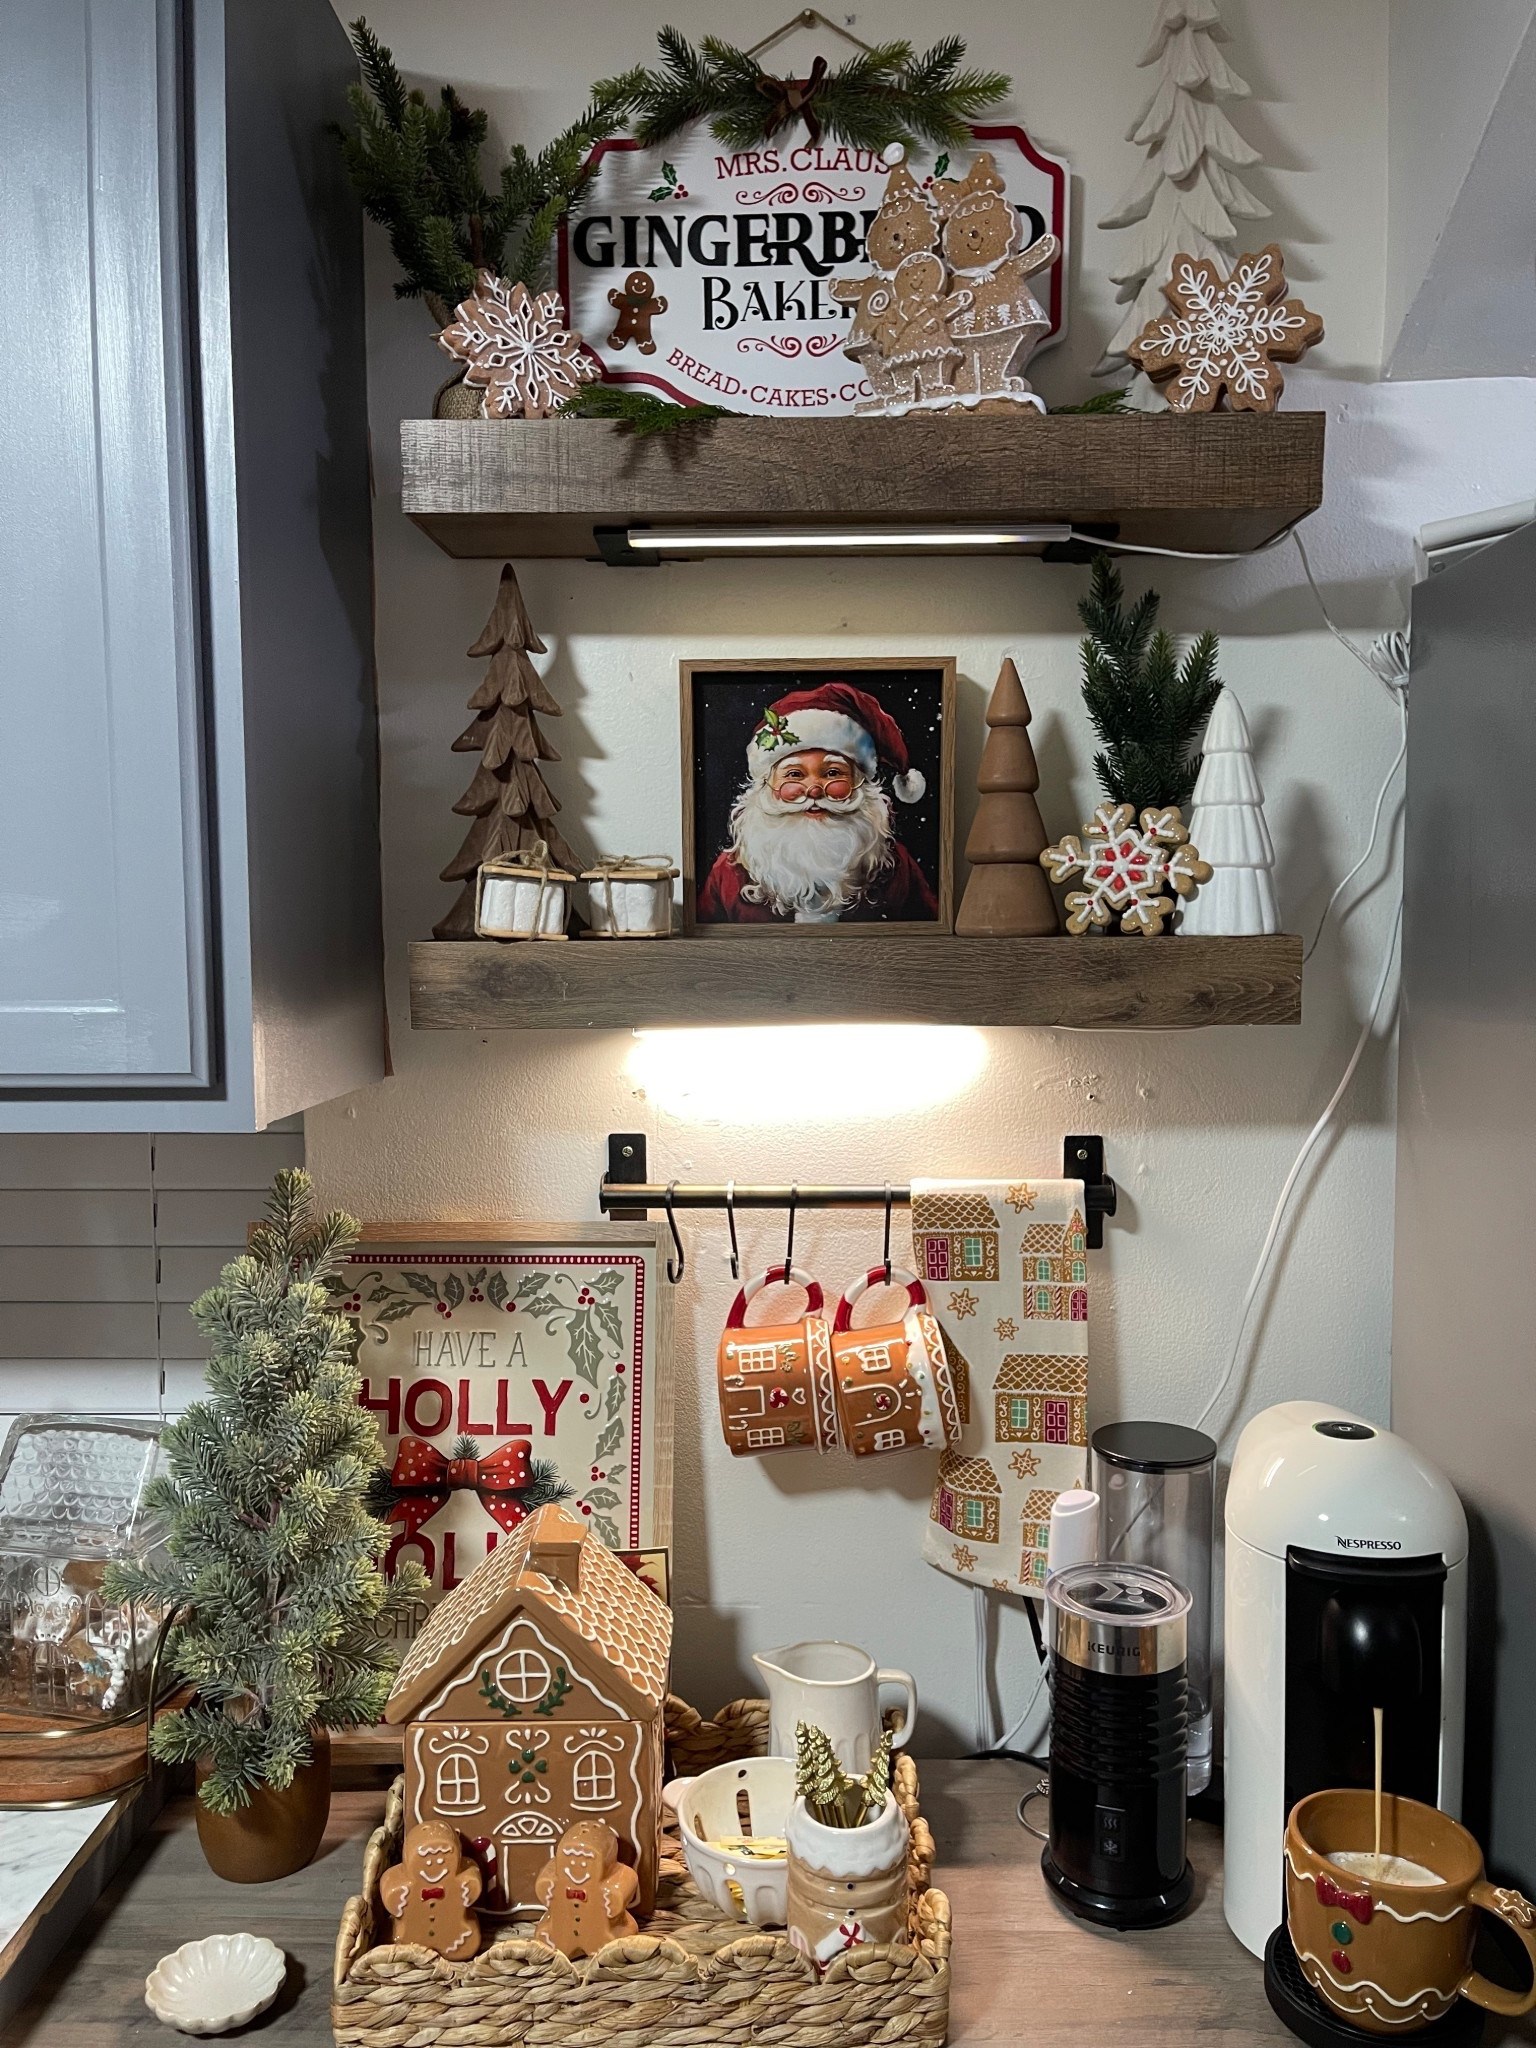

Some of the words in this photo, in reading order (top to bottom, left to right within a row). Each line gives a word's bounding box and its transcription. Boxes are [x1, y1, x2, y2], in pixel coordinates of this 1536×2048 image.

[715, 150, 787, 179] MRS.
[573, 205, 1046, 277] GINGERBD
[702, 276, 853, 330] BAKE
[415, 1331, 496, 1368] HAVE
[506, 1332, 528, 1367] A
[359, 1378, 574, 1437] HOLLY
[1335, 1535, 1402, 1550] NESPRESSO
[1087, 1641, 1141, 1657] KEURIG
